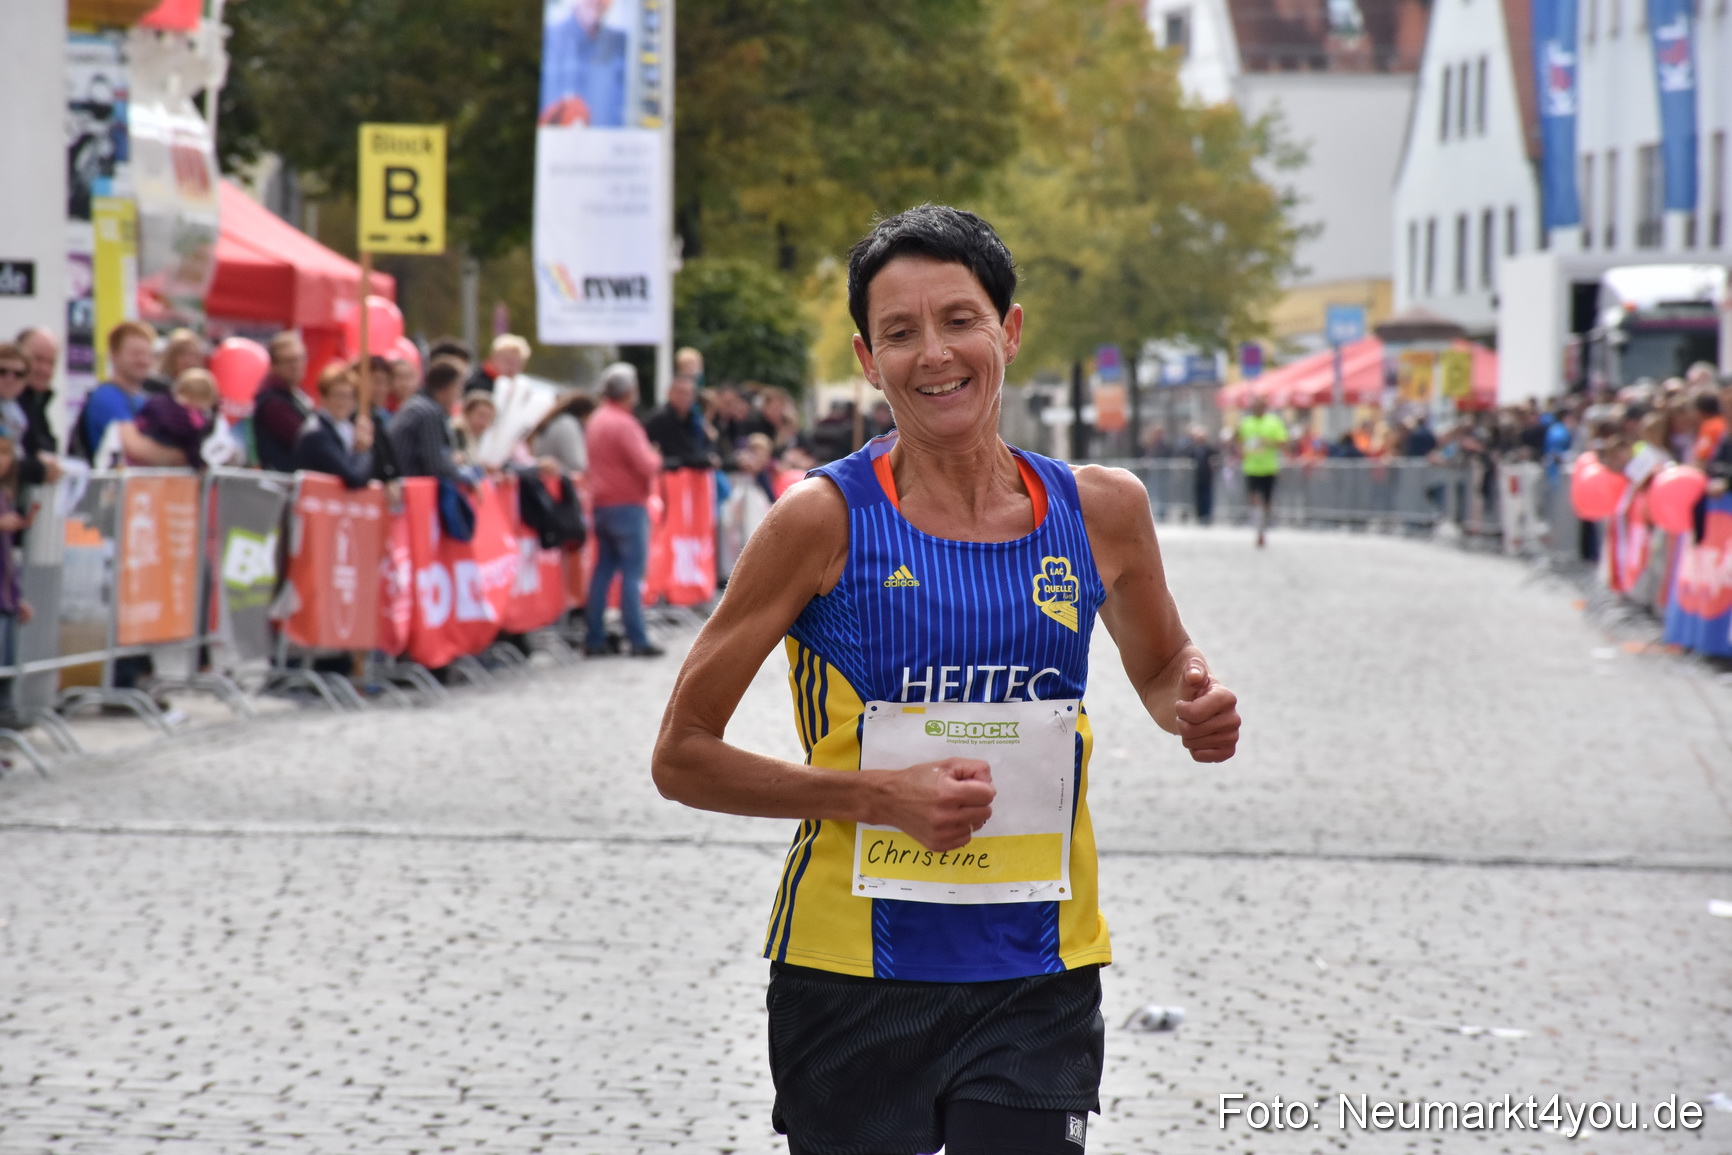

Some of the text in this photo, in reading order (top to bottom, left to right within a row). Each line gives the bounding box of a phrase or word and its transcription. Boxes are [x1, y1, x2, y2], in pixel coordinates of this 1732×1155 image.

[371, 132, 433, 155] Block
[383, 165, 422, 221] B
[1050, 568, 1064, 576] LAC
[883, 578, 920, 588] adidas
[1044, 585, 1073, 593] QUELLE
[901, 665, 1061, 702] HEITEC
[947, 721, 1020, 738] BOCK
[996, 738, 1020, 746] concepts
[867, 839, 991, 869] Christine
